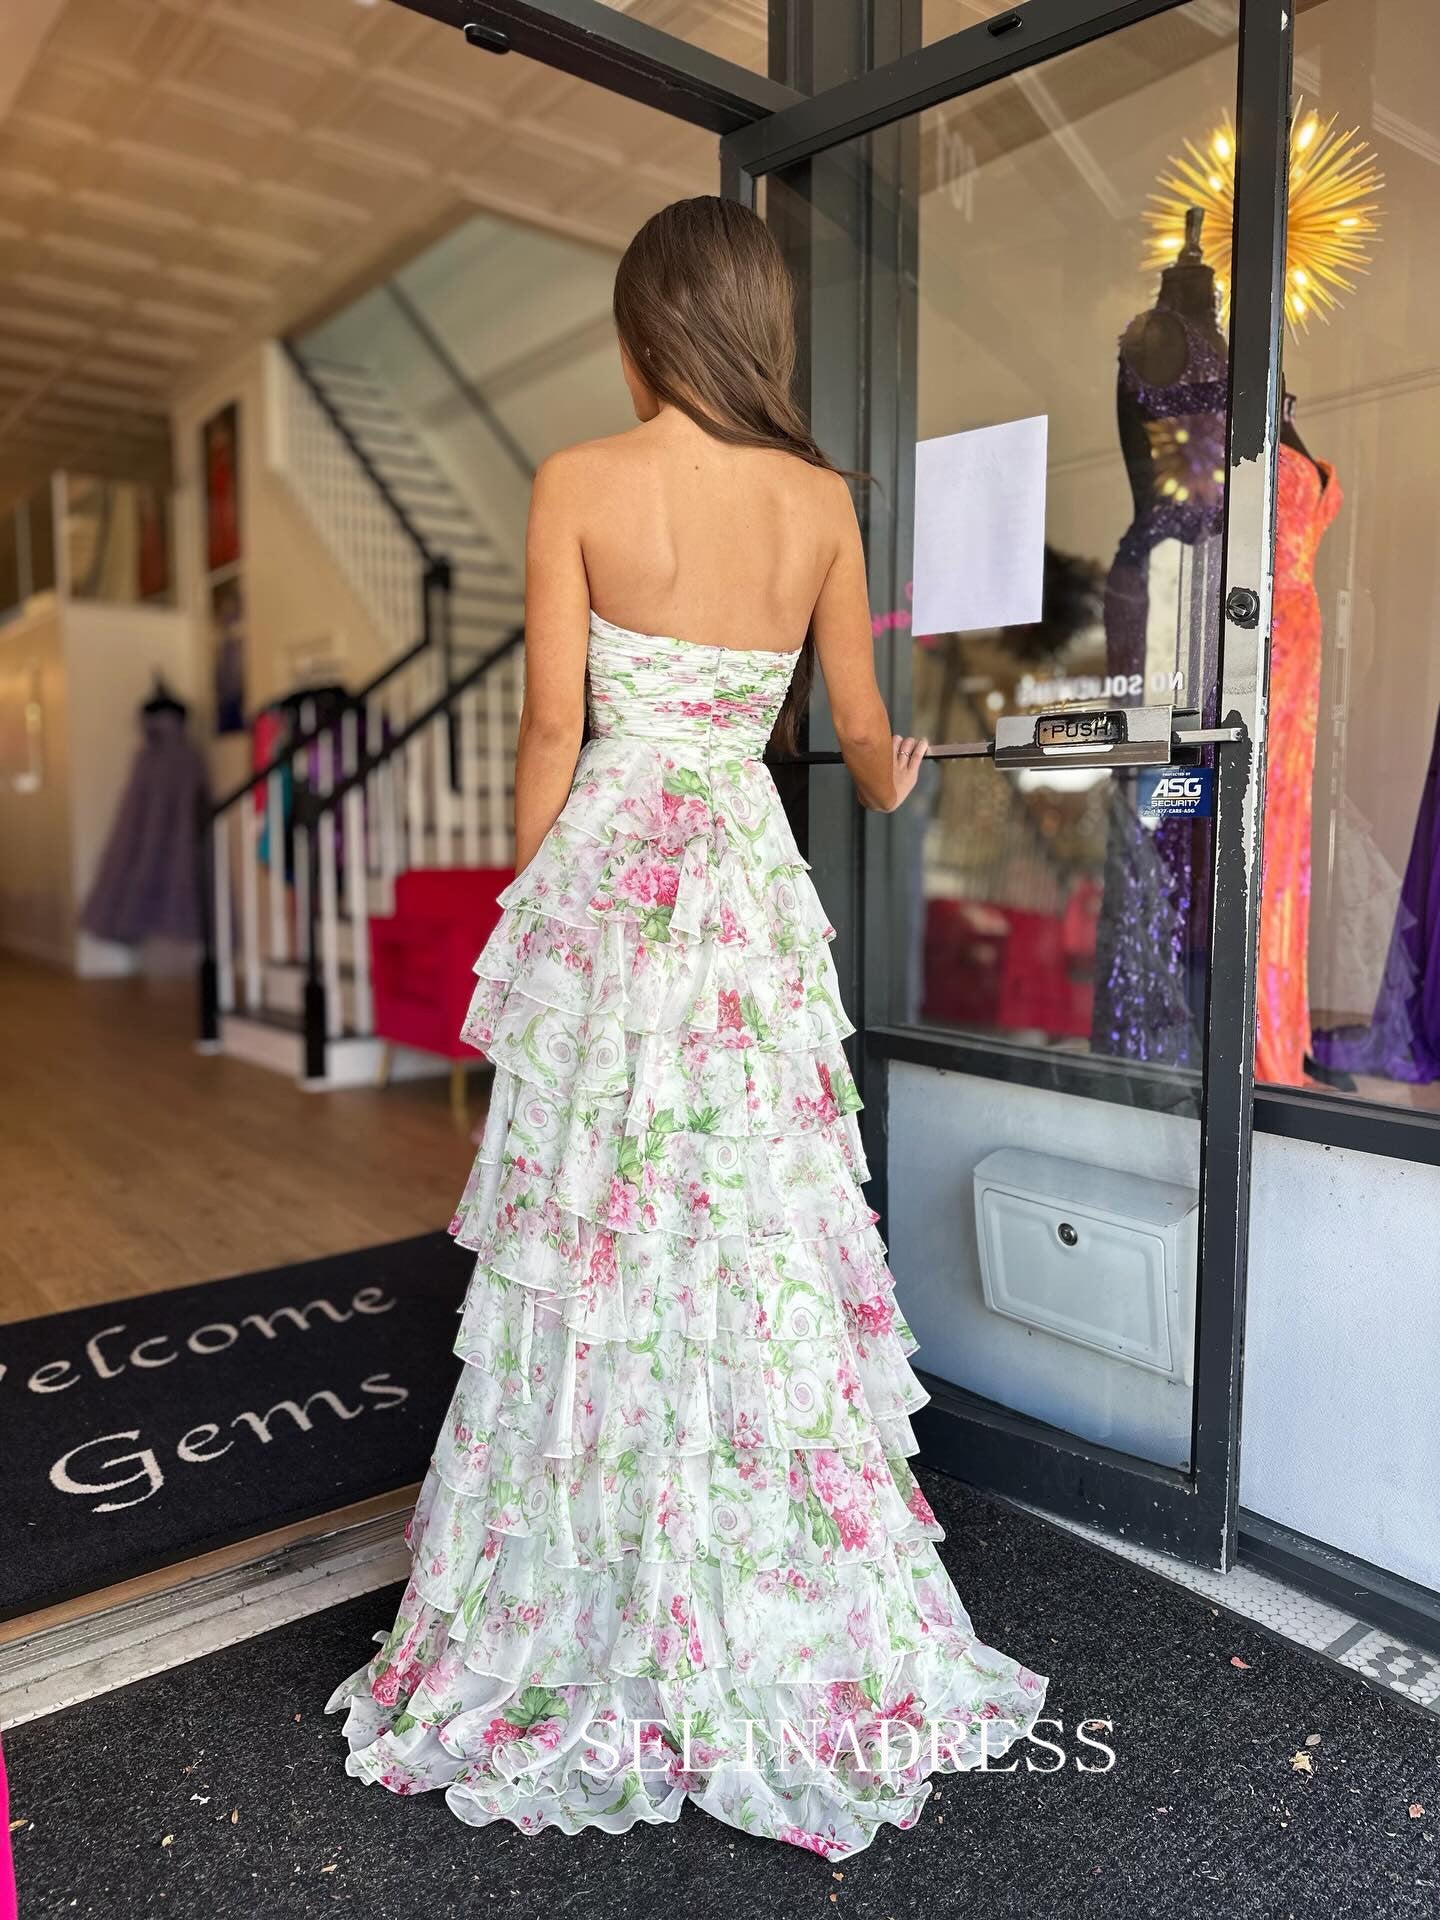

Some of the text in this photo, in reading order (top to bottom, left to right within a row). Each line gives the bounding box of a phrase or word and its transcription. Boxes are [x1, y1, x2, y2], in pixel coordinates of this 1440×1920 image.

[1051, 718, 1109, 739] PUSH
[1151, 777, 1202, 797] ASG
[0, 1287, 396, 1394] elcome
[49, 1373, 409, 1513] Gems
